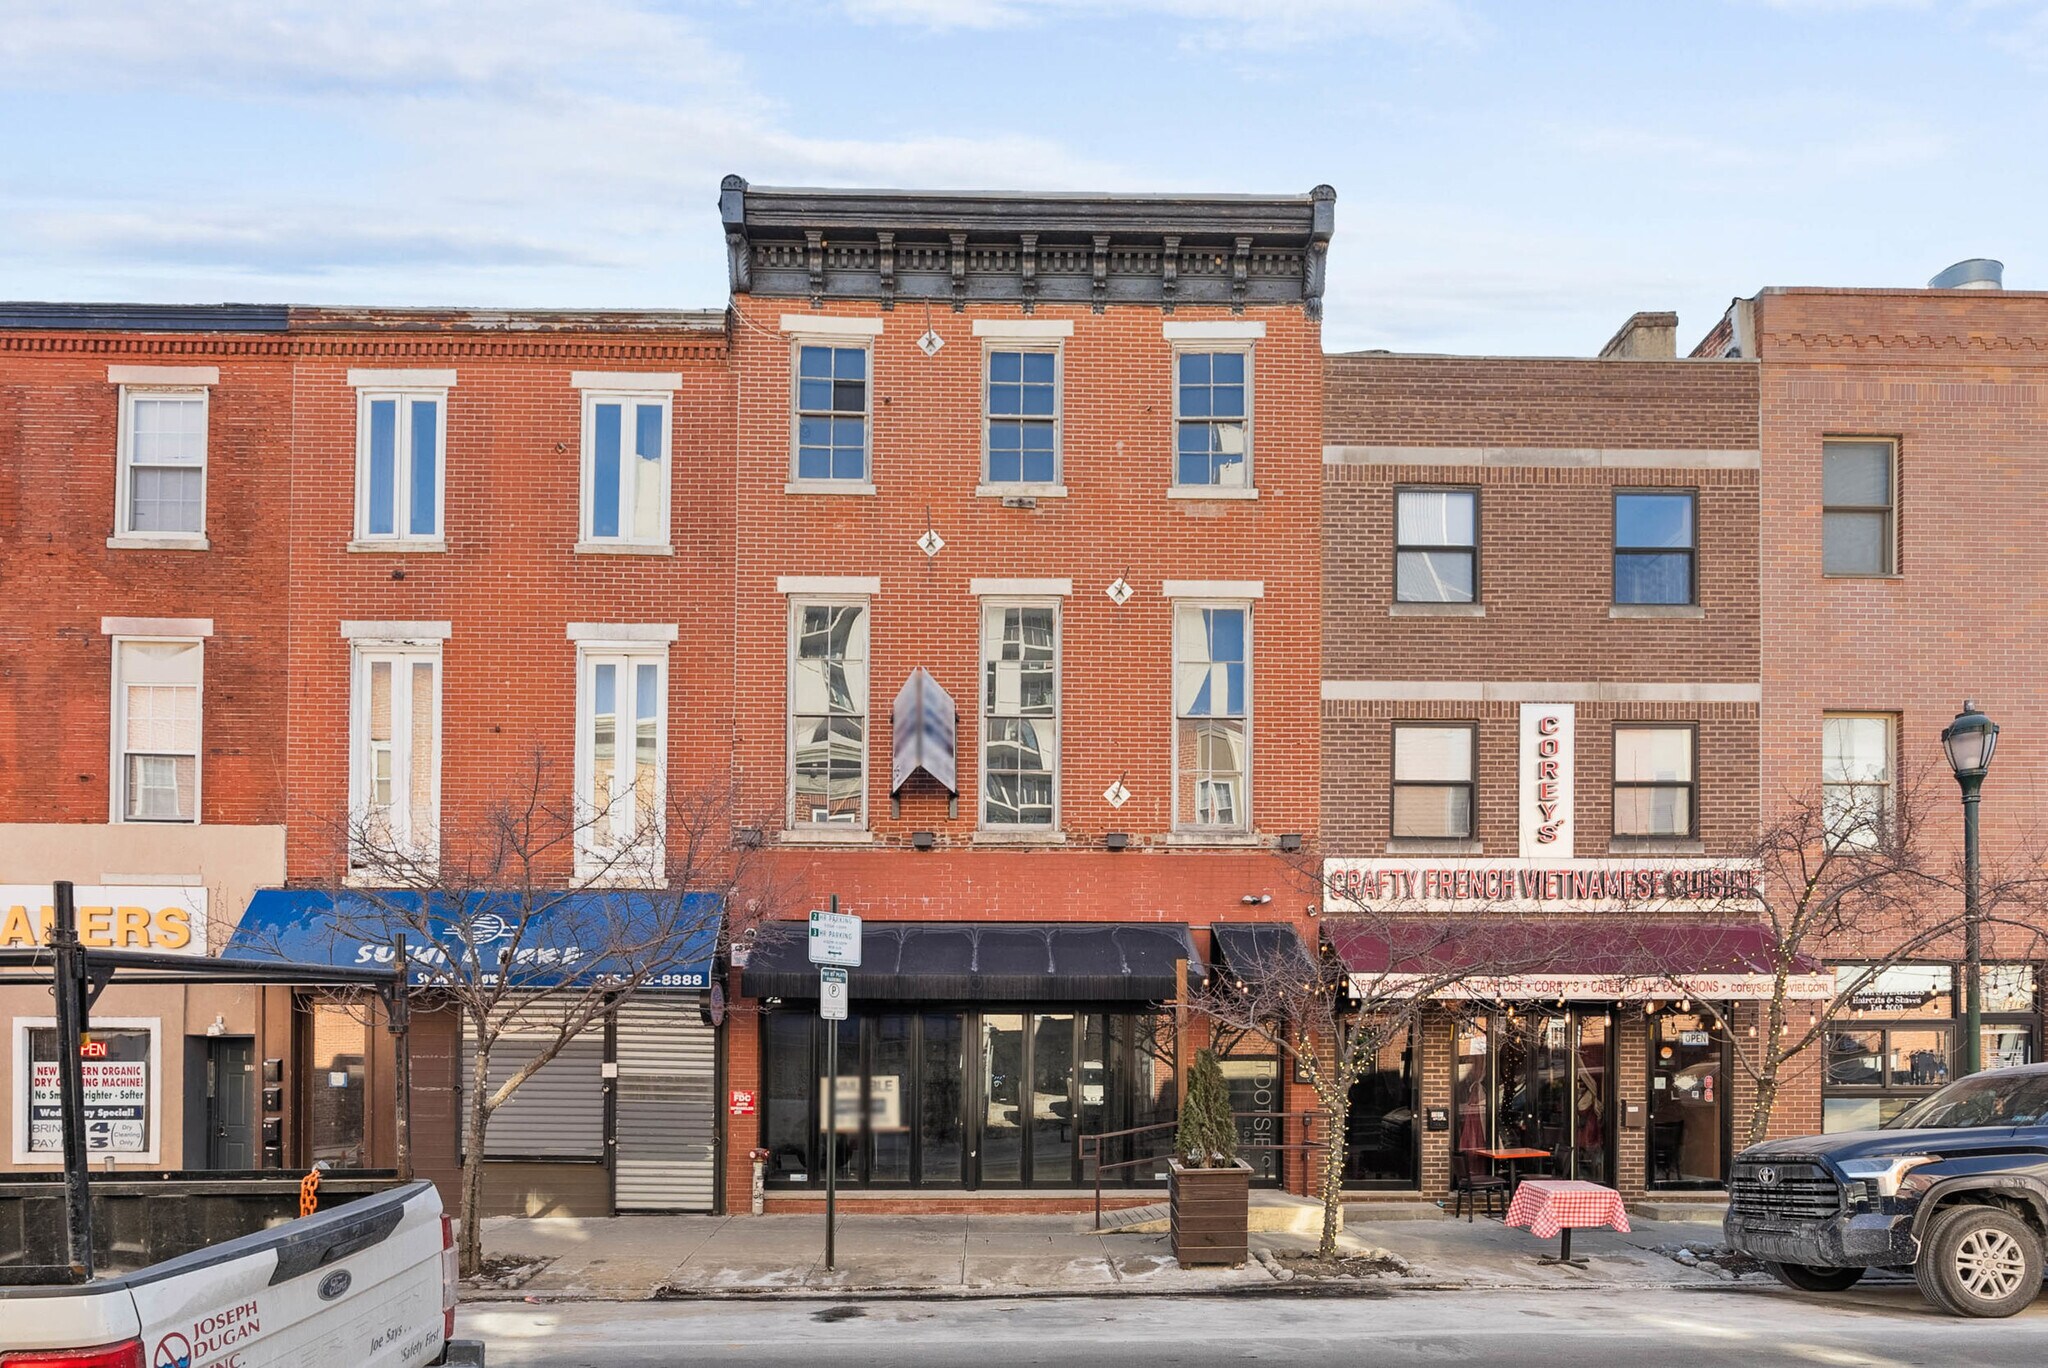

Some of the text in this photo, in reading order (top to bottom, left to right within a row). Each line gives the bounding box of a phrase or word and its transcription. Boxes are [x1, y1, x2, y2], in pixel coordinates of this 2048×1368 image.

[1538, 716, 1565, 844] COREY'S
[1331, 868, 1419, 899] CRAFTY
[1424, 868, 1517, 899] FRENCH
[1521, 868, 1667, 900] VIETNAMESE
[1475, 980, 1499, 992] TAKE
[1503, 980, 1522, 992] OUT
[1534, 980, 1579, 993] COREY'S
[1663, 980, 1719, 993] OCASIONS
[1685, 1033, 1706, 1043] OPEN
[80, 1043, 106, 1056] PEN
[37, 1066, 57, 1076] NEW
[102, 1066, 141, 1076] ORGANIC
[34, 1078, 52, 1087] DRY
[102, 1078, 144, 1087] MACHINE!
[35, 1090, 47, 1100] No
[83, 1090, 113, 1102] righter
[120, 1090, 144, 1100] Softer
[97, 1107, 135, 1119] Special!
[32, 1122, 110, 1133] BRIN 4
[31, 1139, 57, 1148] PAY
[89, 1136, 109, 1148] 3
[193, 1301, 258, 1341] JOSEPH
[193, 1318, 260, 1359] DUGAN
[369, 1336, 384, 1356] Joe
